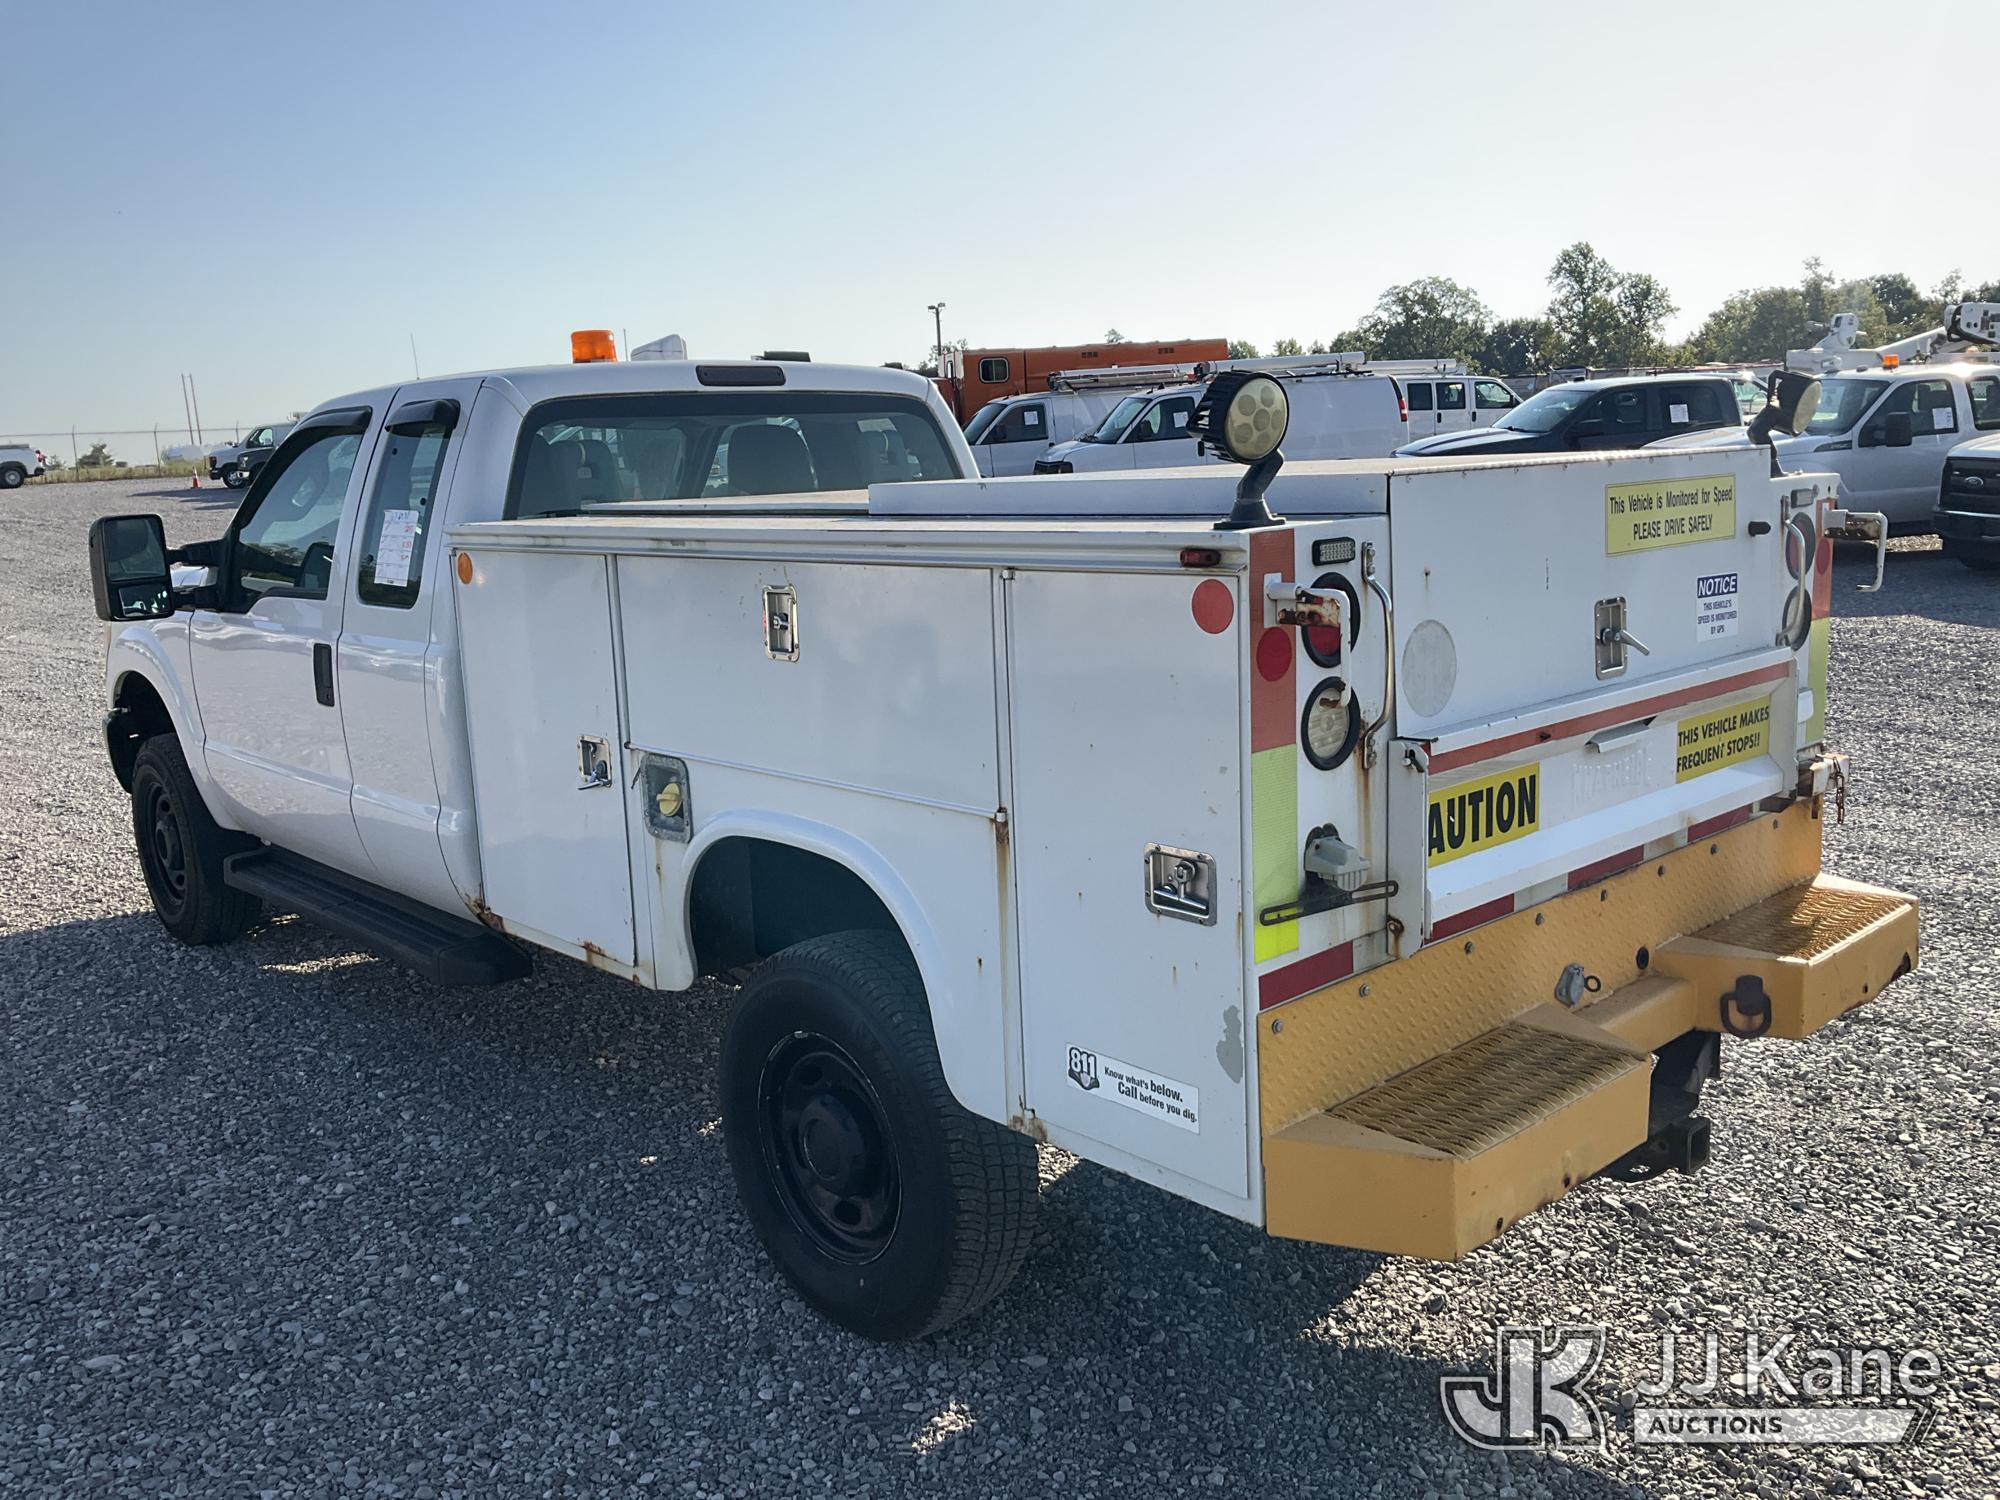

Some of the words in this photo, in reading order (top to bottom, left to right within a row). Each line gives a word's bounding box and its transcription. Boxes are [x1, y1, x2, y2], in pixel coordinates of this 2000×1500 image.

[1610, 497, 1625, 514] This
[1628, 493, 1653, 512] Vehicle
[1656, 492, 1663, 509] is
[1666, 489, 1699, 508] Monitored
[1701, 488, 1711, 504] for
[1713, 485, 1733, 507] Speed
[1633, 520, 1661, 541] PLEASE
[1664, 517, 1685, 536] DRIVE
[1688, 514, 1713, 533] SAFELY
[1698, 575, 1737, 596] NOTICE
[1677, 729, 1699, 747] THIS
[1702, 717, 1737, 740] VEHICLE
[1739, 706, 1770, 727] MAKES
[1677, 742, 1726, 773] FREQUENT
[1727, 732, 1761, 757] STOPS!!
[1428, 774, 1536, 857] AUTION
[1069, 1046, 1097, 1080] 811
[1104, 1066, 1124, 1081] Know
[1125, 1075, 1149, 1090] what's
[1150, 1080, 1183, 1103] below.
[1118, 1082, 1138, 1100] Call
[1139, 1092, 1165, 1110] before
[1166, 1103, 1181, 1116] you
[1182, 1108, 1198, 1123] dig.
